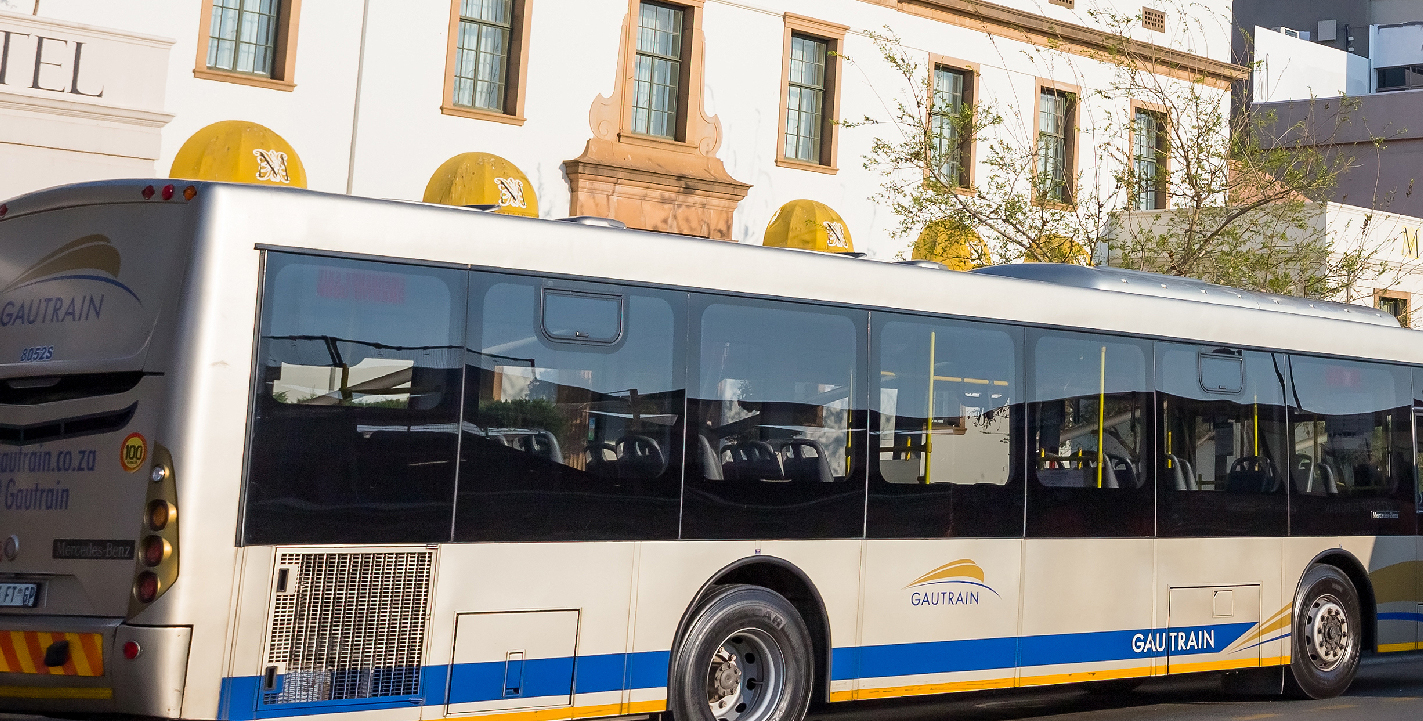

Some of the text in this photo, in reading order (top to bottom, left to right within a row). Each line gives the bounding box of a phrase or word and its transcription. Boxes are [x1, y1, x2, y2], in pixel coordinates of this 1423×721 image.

[0, 294, 104, 327] GAUTRAIN
[125, 445, 143, 460] 100
[5, 477, 70, 511] Gautrain
[56, 541, 131, 558] Mercedes-Benz
[910, 590, 980, 607] GAUTRAIN
[1132, 629, 1215, 654] GAUTRAIN
